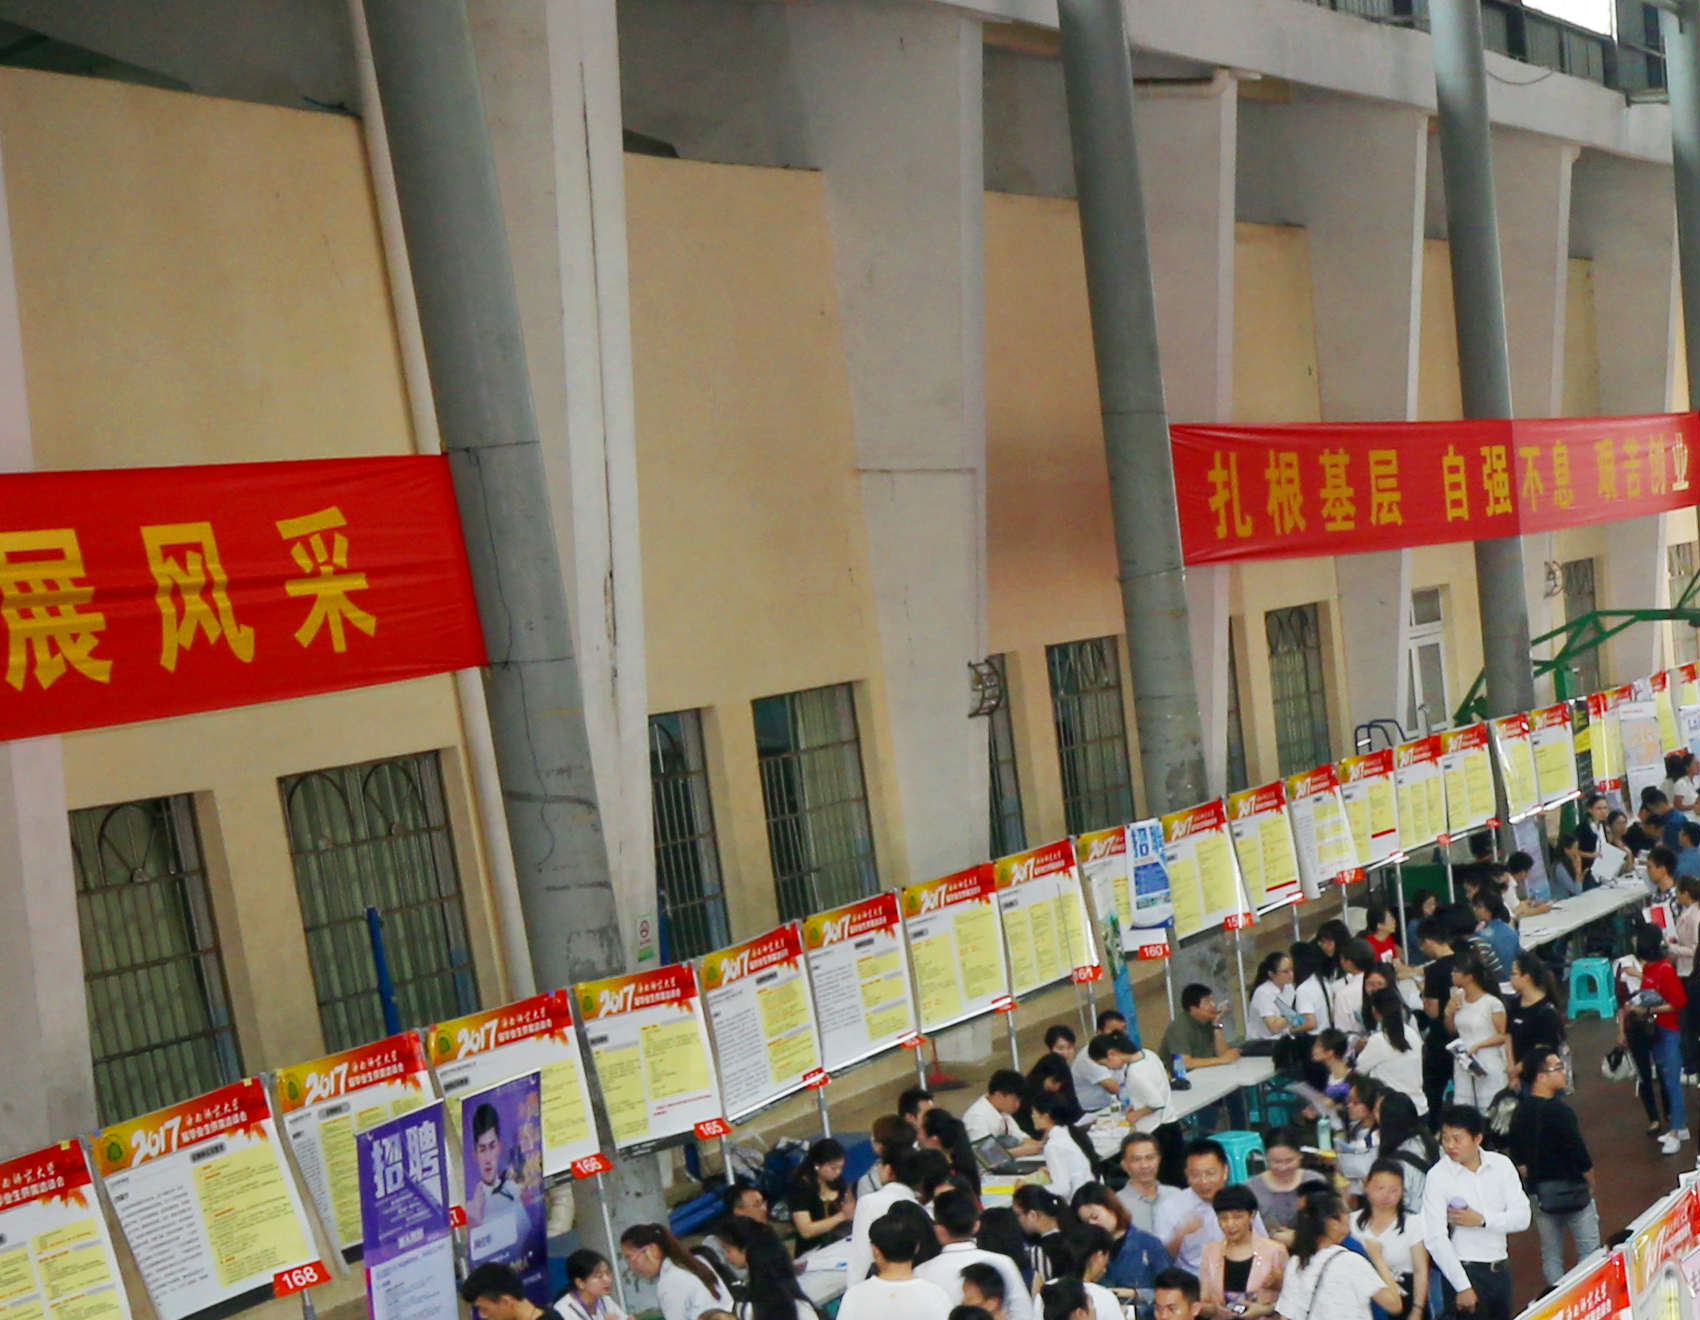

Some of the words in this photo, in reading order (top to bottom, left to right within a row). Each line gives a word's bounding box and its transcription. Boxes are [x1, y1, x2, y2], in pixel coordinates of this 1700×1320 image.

[1208, 448, 1403, 540] 扎根基层
[1442, 440, 1573, 522] 自强不息
[598, 982, 637, 1019] 2017
[456, 1018, 500, 1060] 2017
[304, 1062, 350, 1105] 2017
[130, 1115, 182, 1168] 2017
[699, 1120, 725, 1137] 165
[371, 1119, 442, 1200] 招聘
[575, 1156, 604, 1174] 166
[281, 1266, 319, 1290] 168
